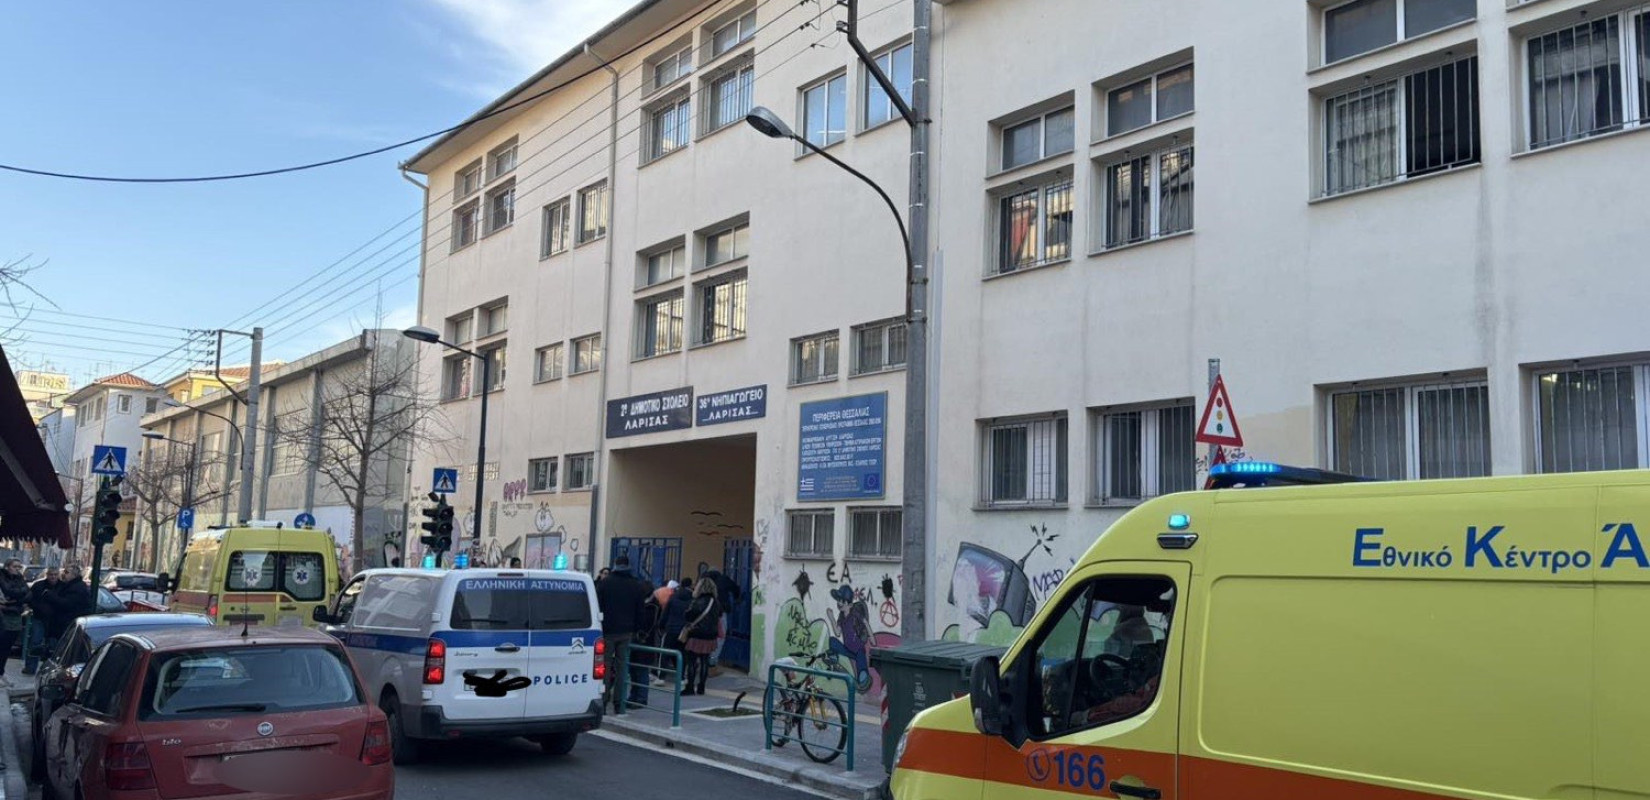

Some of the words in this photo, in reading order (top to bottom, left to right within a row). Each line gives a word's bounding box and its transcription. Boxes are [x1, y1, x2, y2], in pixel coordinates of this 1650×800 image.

[630, 399, 660, 416] ΔΗΜΟΤΙΚΟ
[662, 394, 689, 411] ΣΧΟΛΕΙΟ
[711, 388, 763, 407] ΝΗΠΙΑΓΩΓΕΙΟ
[624, 414, 669, 430] ΛΑΡΙΣΑΣ
[812, 410, 841, 423] ΠΕΡΙΦΕΡΕΙΑ
[182, 510, 191, 519] P
[1352, 528, 1453, 568] Εθνικό
[1464, 525, 1592, 574] Κέντρο
[465, 580, 526, 590] ΕΛΛΗΝΙΚΗ
[530, 581, 584, 591] ΑΣΤΥΝΟΜΙΑ
[533, 673, 588, 686] POLICE
[1053, 750, 1107, 791] 166
